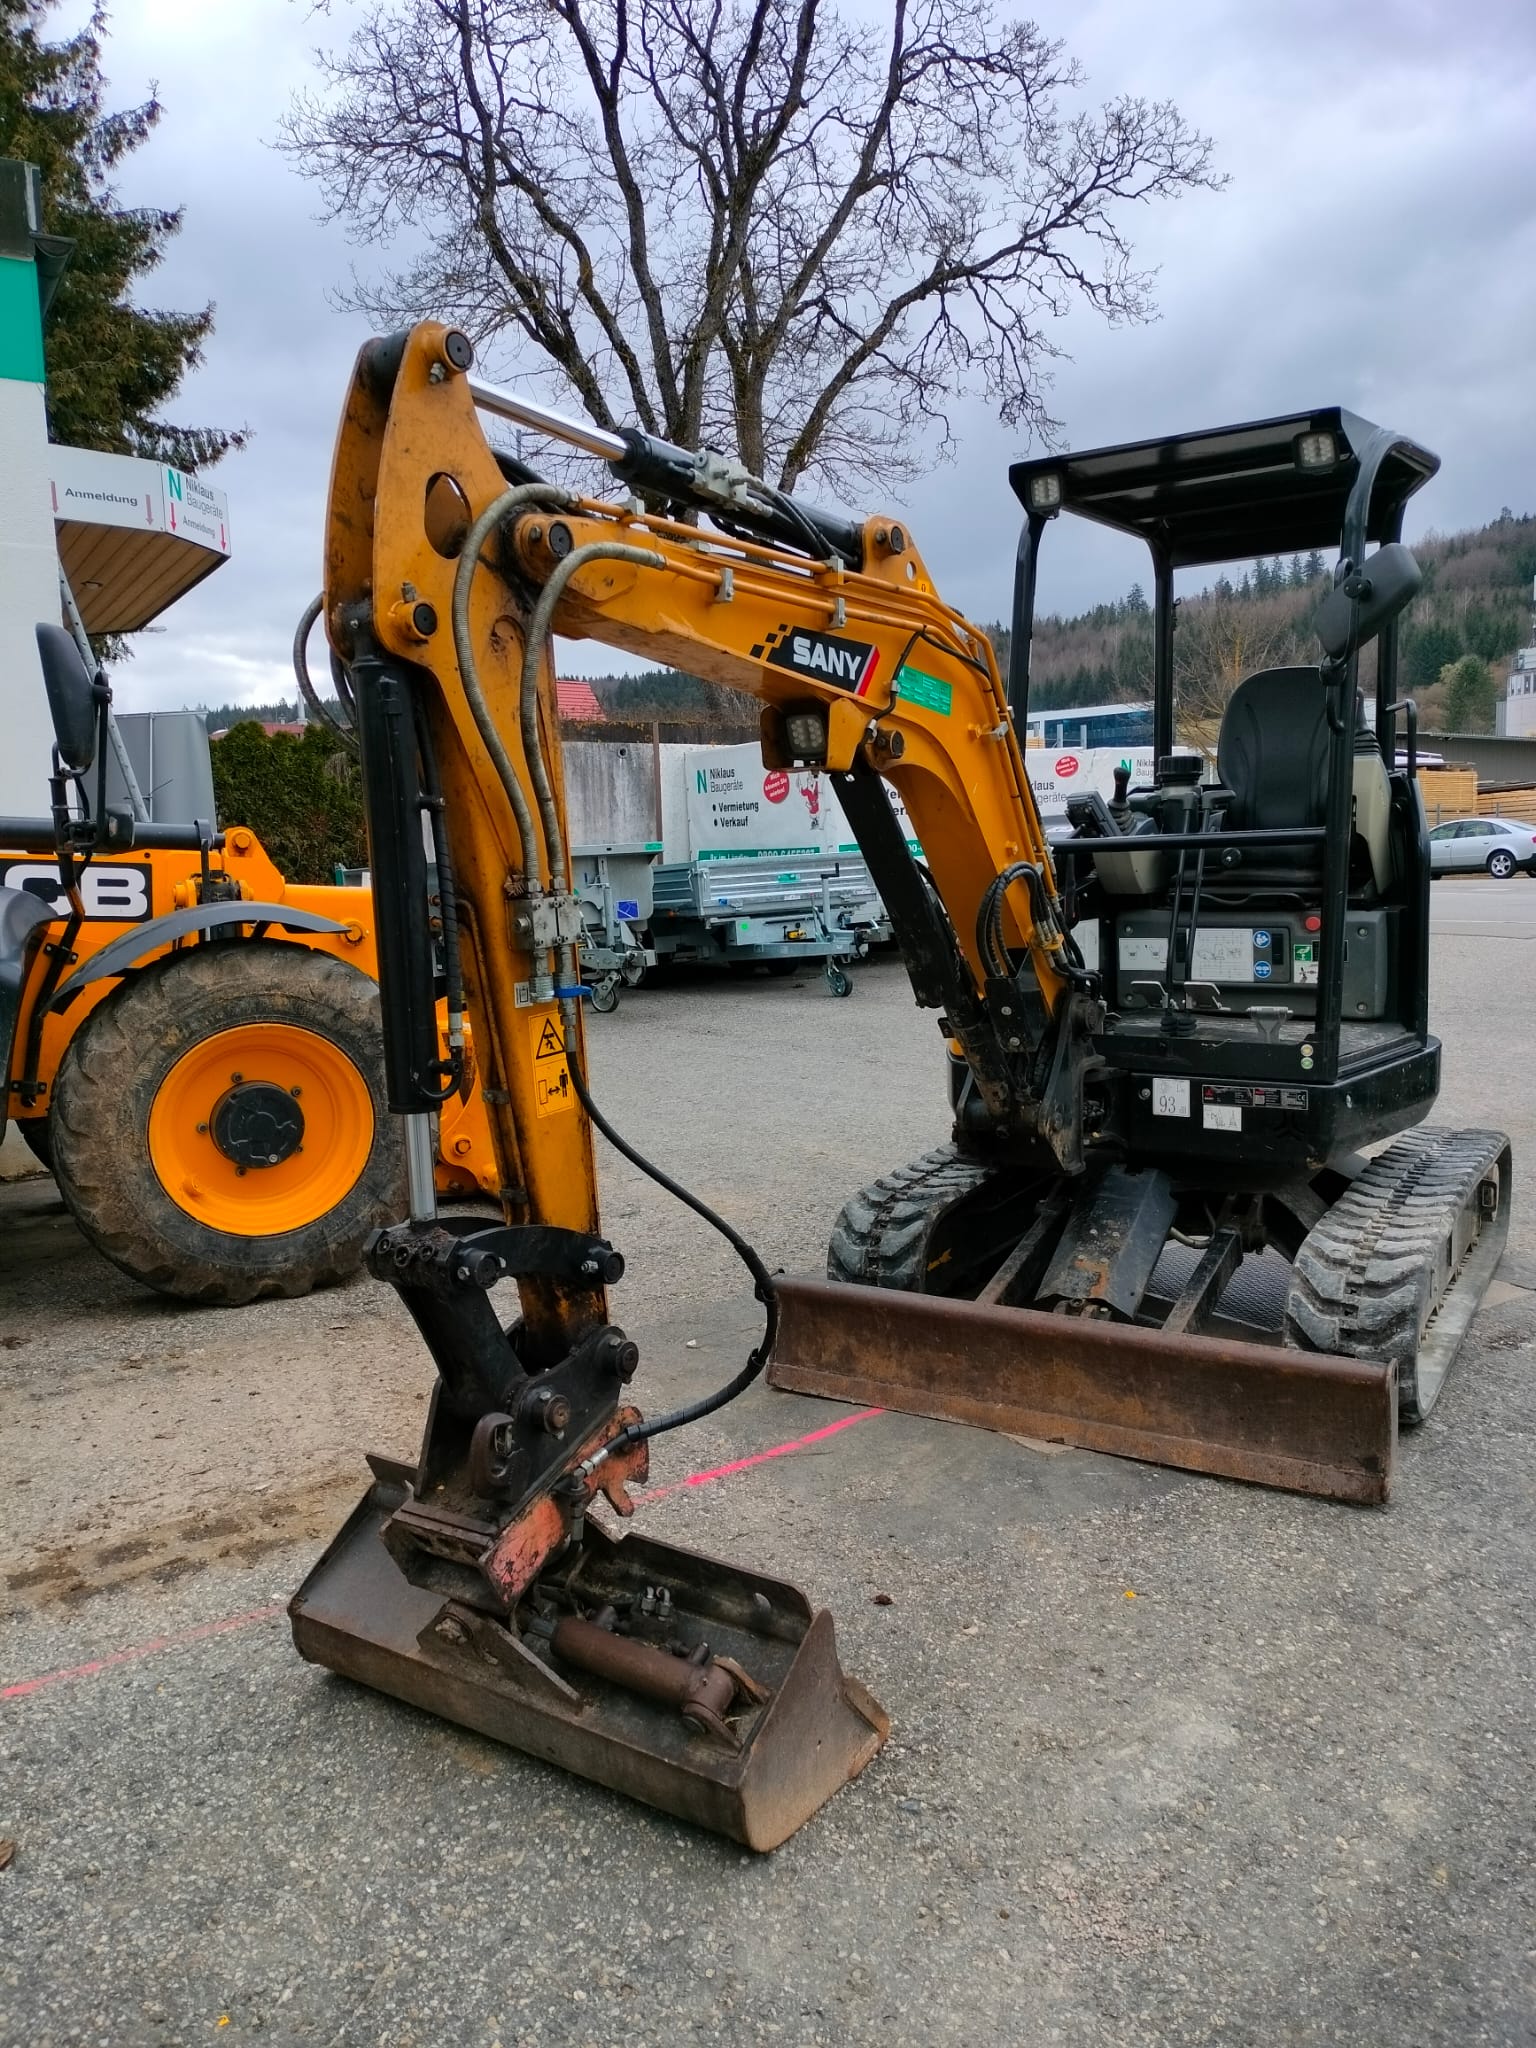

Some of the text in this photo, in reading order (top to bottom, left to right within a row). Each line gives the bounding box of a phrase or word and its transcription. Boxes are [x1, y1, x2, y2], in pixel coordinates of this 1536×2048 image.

[168, 469, 182, 501] N
[185, 477, 215, 502] Niklaus
[65, 488, 138, 507] Anmeldung
[186, 493, 224, 520] Baugeräte
[183, 515, 216, 539] Anmeldung
[793, 636, 862, 680] SANY
[1136, 759, 1154, 767] Nikla
[696, 769, 708, 794] N
[709, 768, 735, 779] Niklaus
[710, 780, 743, 795] Baugeräte
[719, 801, 759, 813] Vermietung
[1036, 792, 1067, 807] geräte
[720, 816, 749, 828] Verkauf
[4, 864, 148, 917] CB
[1159, 1095, 1176, 1114] 93
